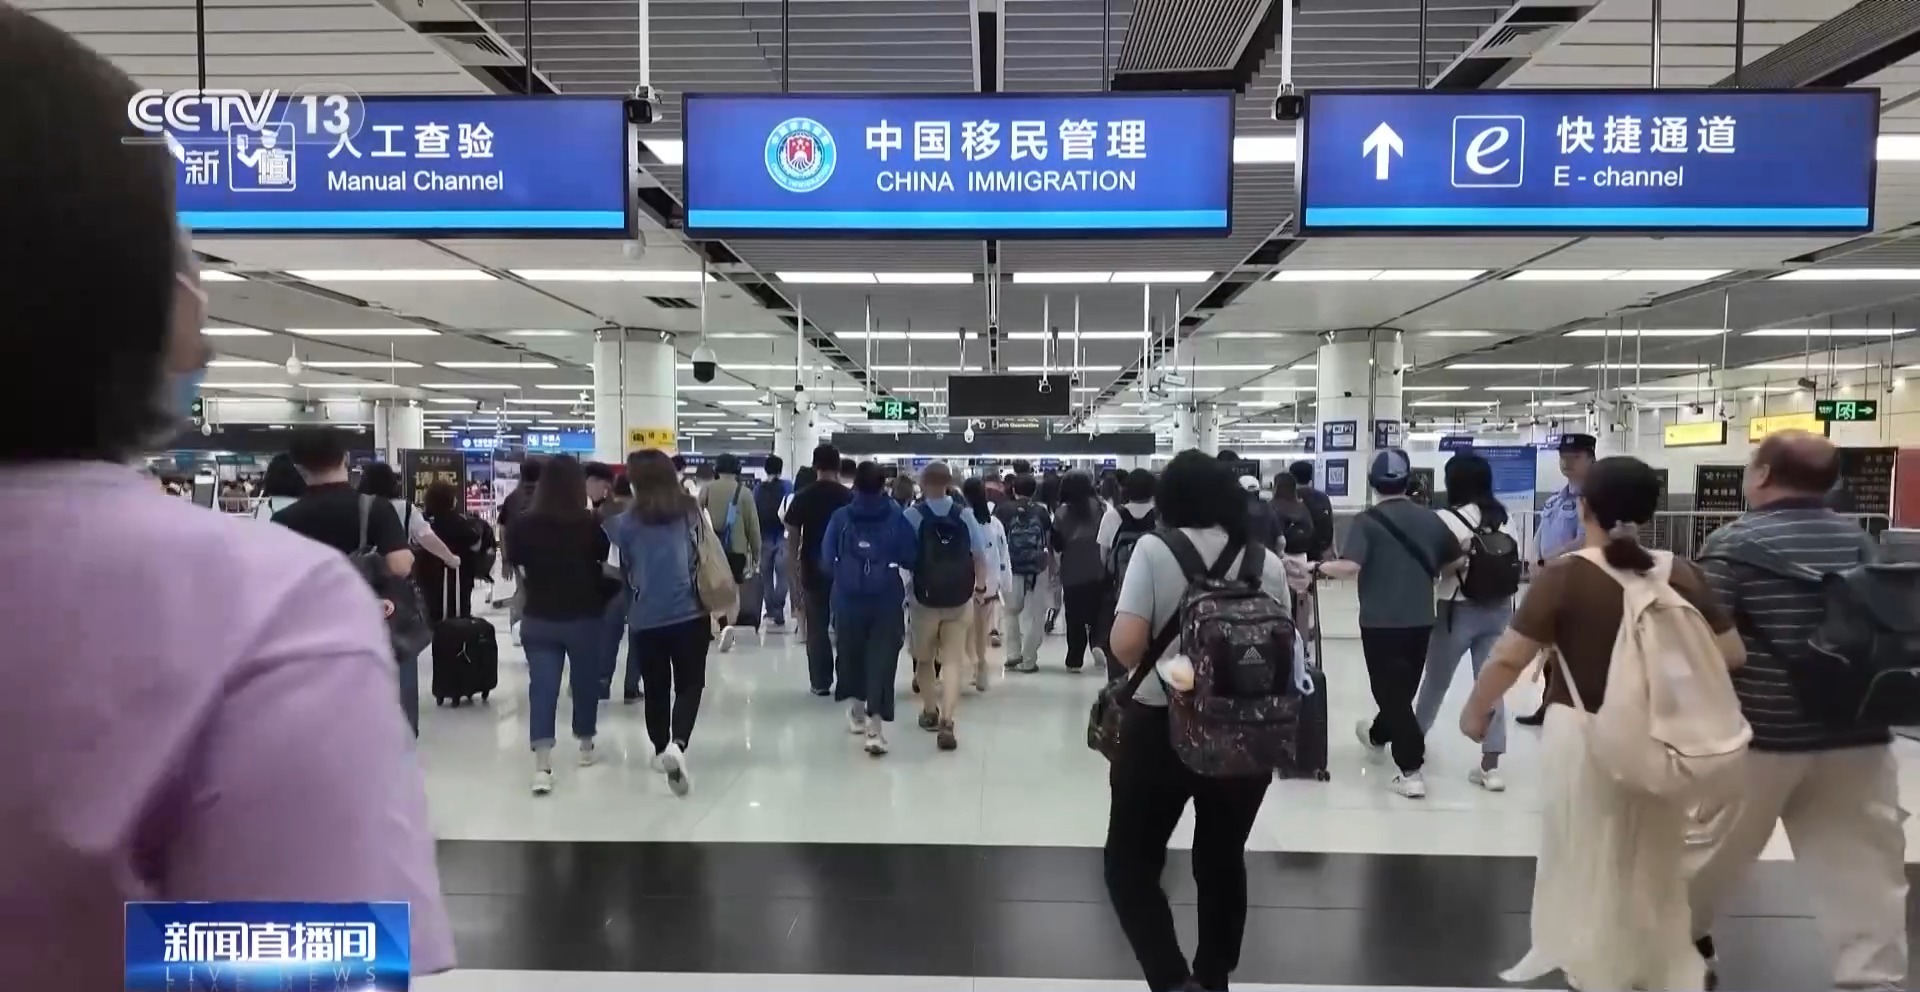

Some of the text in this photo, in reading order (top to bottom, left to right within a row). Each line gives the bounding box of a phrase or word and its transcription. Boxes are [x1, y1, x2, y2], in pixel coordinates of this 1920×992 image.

[327, 121, 494, 159] 人工查验
[865, 119, 1147, 161] 中国移民管理
[1556, 115, 1737, 154] 快捷通道
[327, 170, 504, 191] Manual Channel
[876, 170, 1136, 192] CHINA IMMIGRATION
[1554, 166, 1570, 186] E
[1593, 166, 1684, 187] channel
